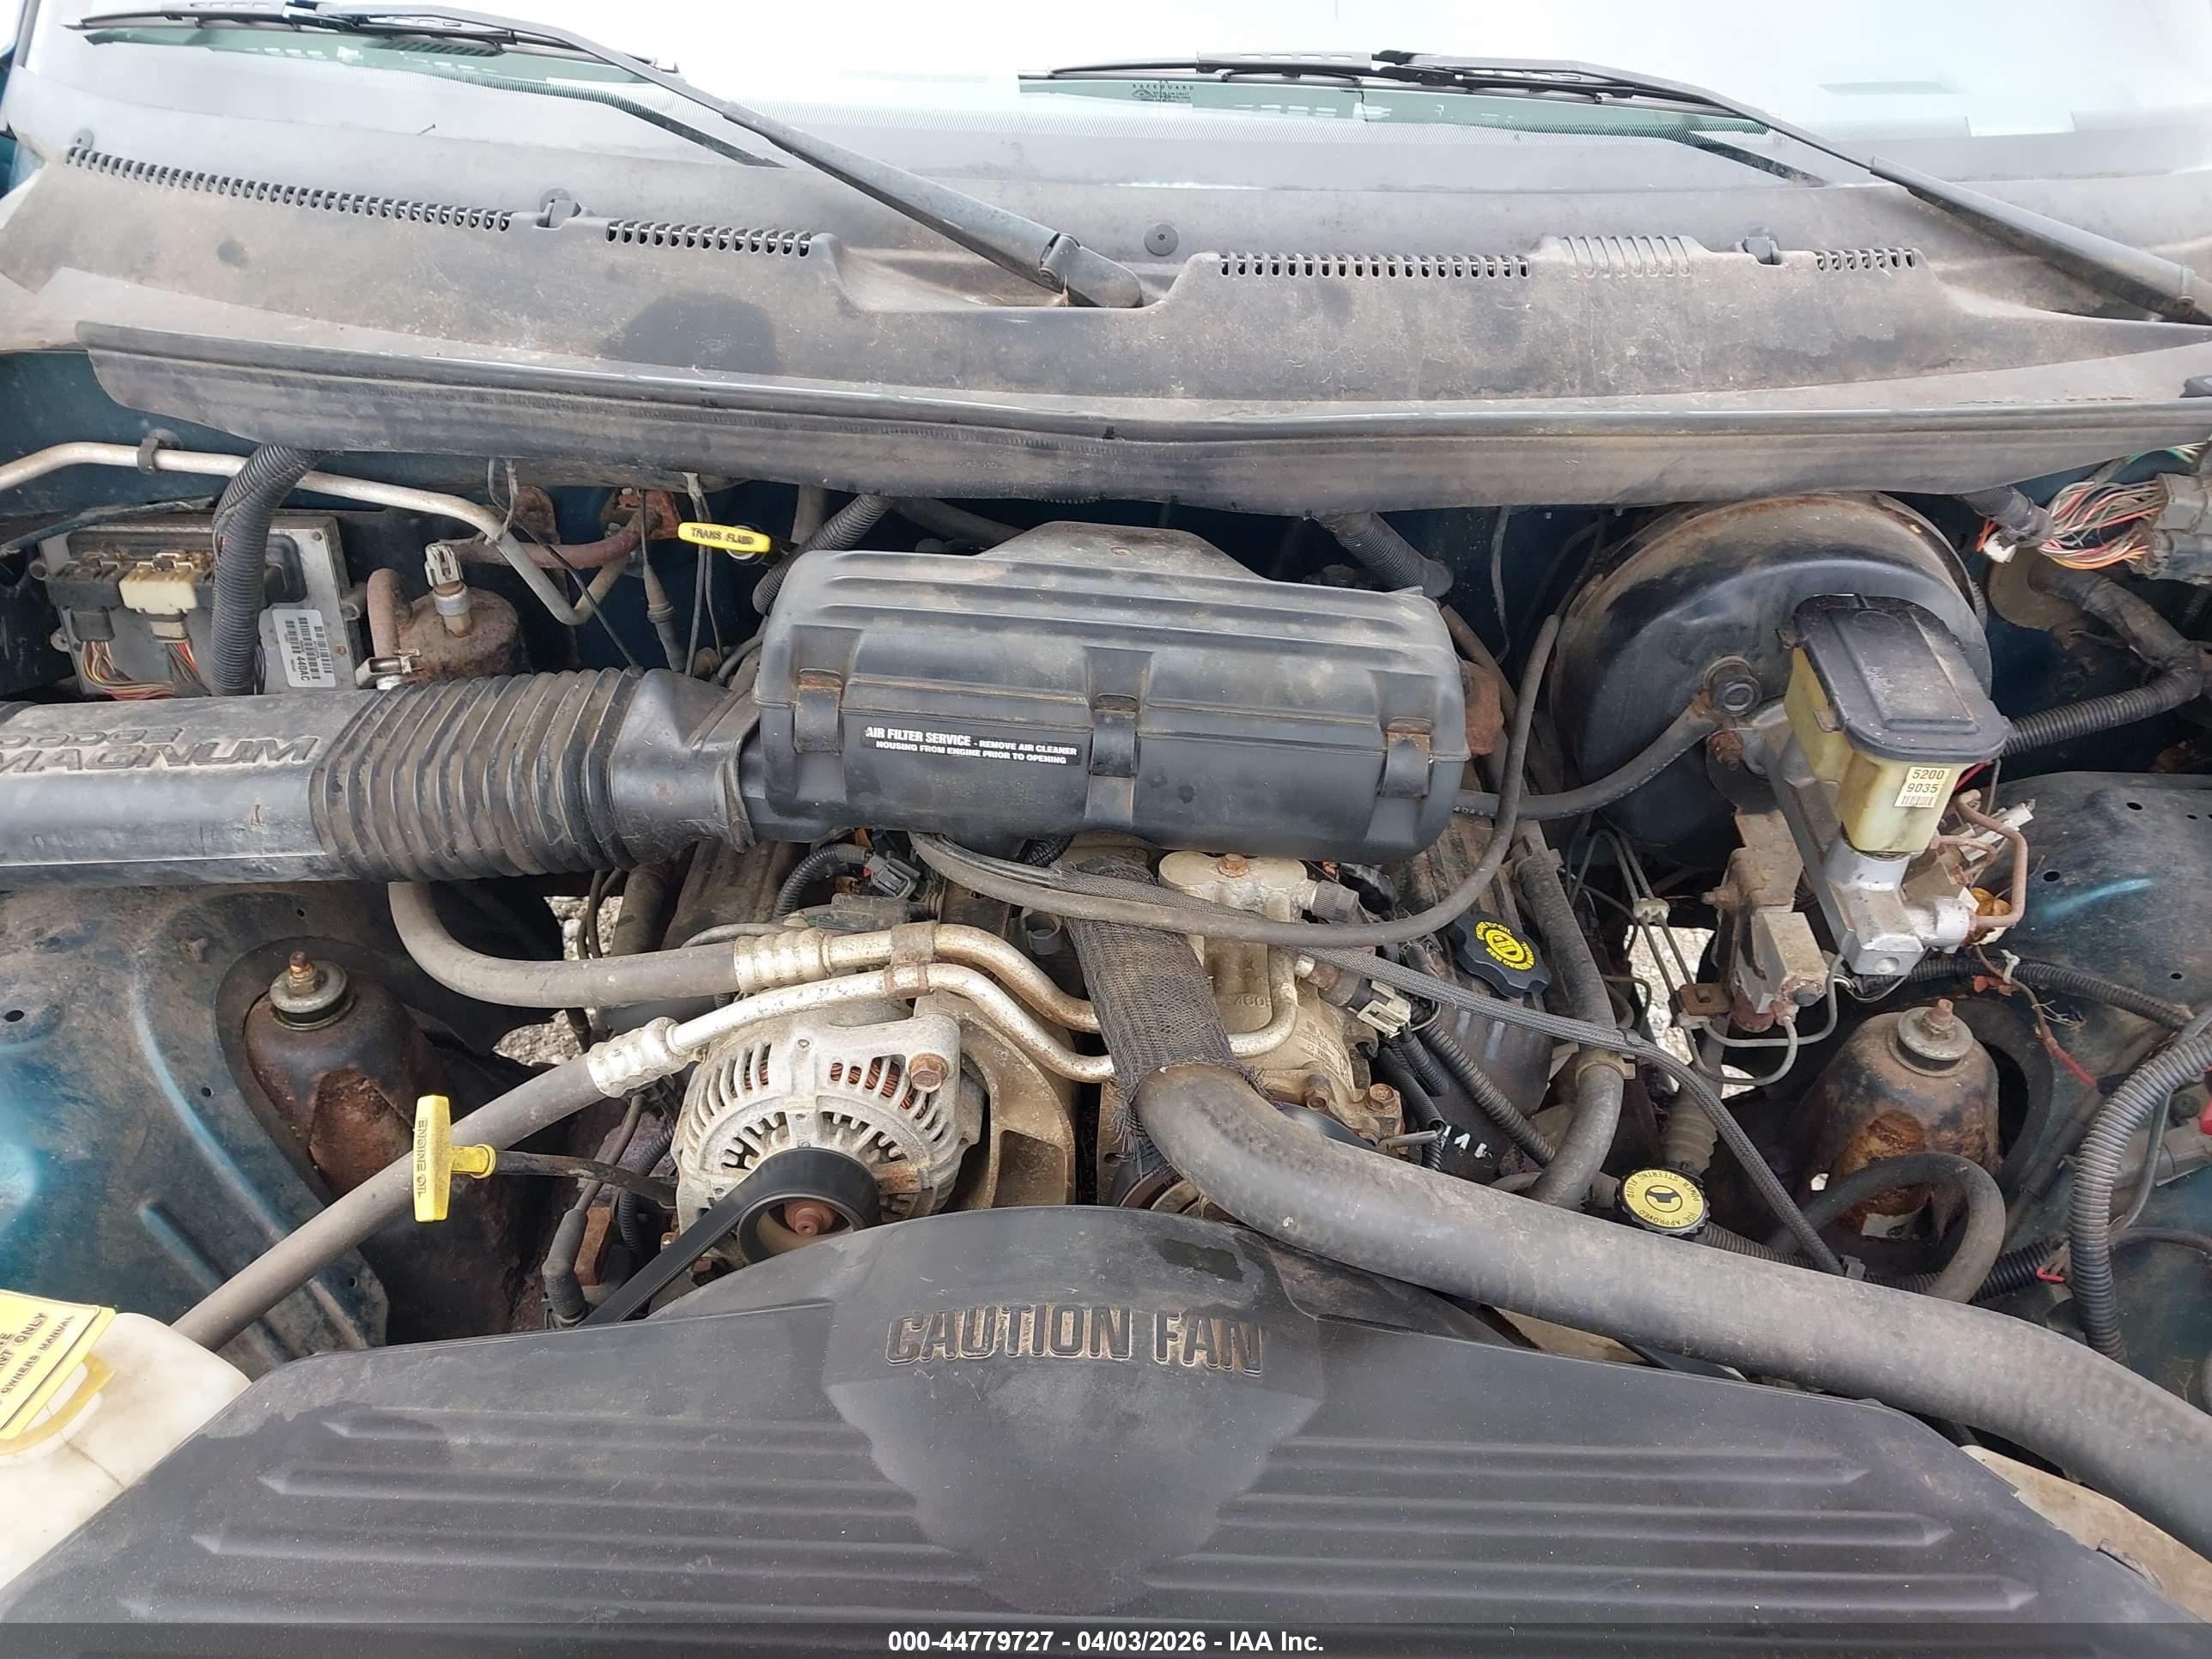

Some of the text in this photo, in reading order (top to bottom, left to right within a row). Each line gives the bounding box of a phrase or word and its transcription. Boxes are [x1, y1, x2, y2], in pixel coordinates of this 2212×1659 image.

[690, 526, 755, 546] TRANS FLUID
[297, 656, 310, 682] 440AC
[865, 726, 885, 738] AIR
[887, 728, 923, 742] FILTER
[926, 732, 971, 746] SERVICE
[979, 739, 1017, 750] REMOVE
[1035, 744, 1077, 756] CLEANER
[876, 740, 918, 751] HOUSING
[919, 744, 945, 754] FROM
[946, 747, 981, 757] ENGINE
[982, 750, 1011, 759] PRIOR
[1025, 754, 1066, 764] OPENING
[1906, 783, 1939, 793] 9035
[1912, 769, 1945, 780] 5200
[416, 1118, 428, 1198] ENGINE OIL
[1626, 1171, 1700, 1202] POWER STEERING FLUID
[1638, 1209, 1698, 1226] USE APPROVED
[14, 1312, 48, 1345] ONLY
[886, 1304, 1262, 1376] CAUTION FAN
[1, 1316, 75, 1395] OWNERS MANUAL
